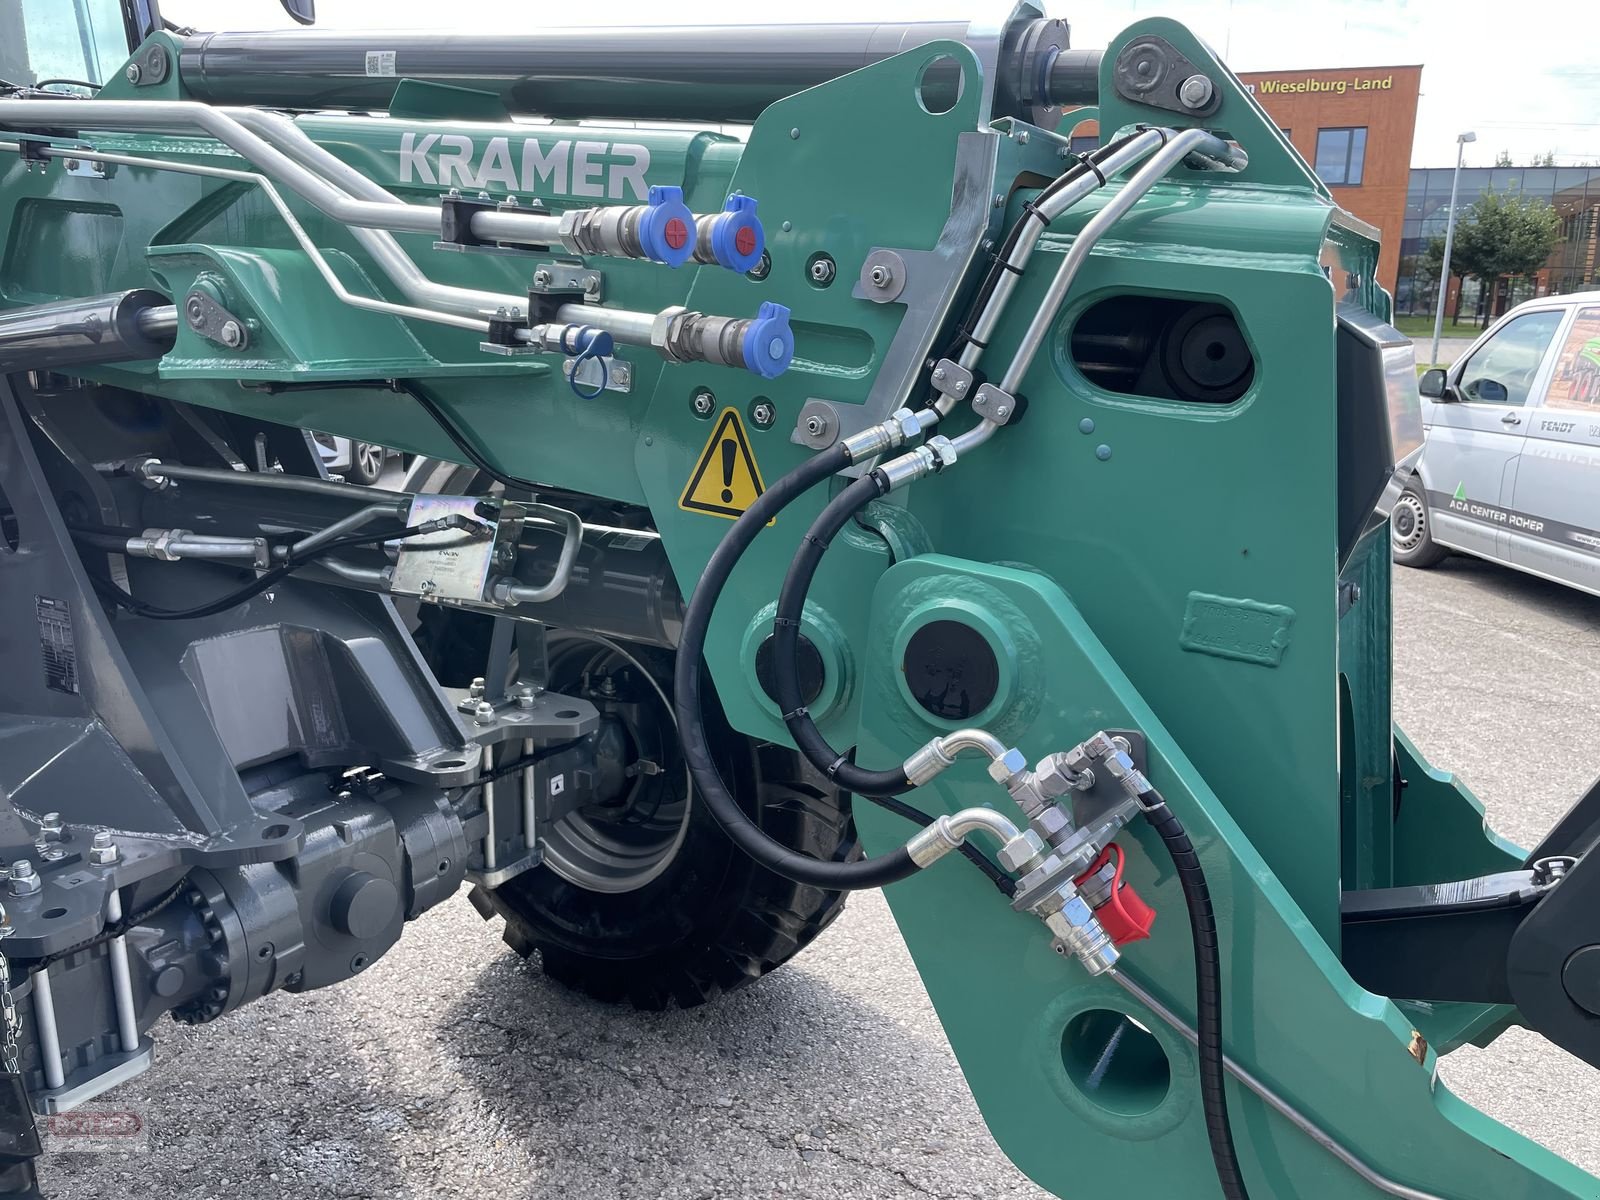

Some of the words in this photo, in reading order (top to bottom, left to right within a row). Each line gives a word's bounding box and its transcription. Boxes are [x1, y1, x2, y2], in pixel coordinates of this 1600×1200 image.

[1260, 76, 1393, 95] Wieselburg-Land
[399, 132, 651, 200] KRAMER
[1541, 420, 1576, 433] FENDT
[1449, 500, 1469, 512] ACA
[1470, 504, 1507, 522] CENTER
[1509, 515, 1545, 532] ROHER
